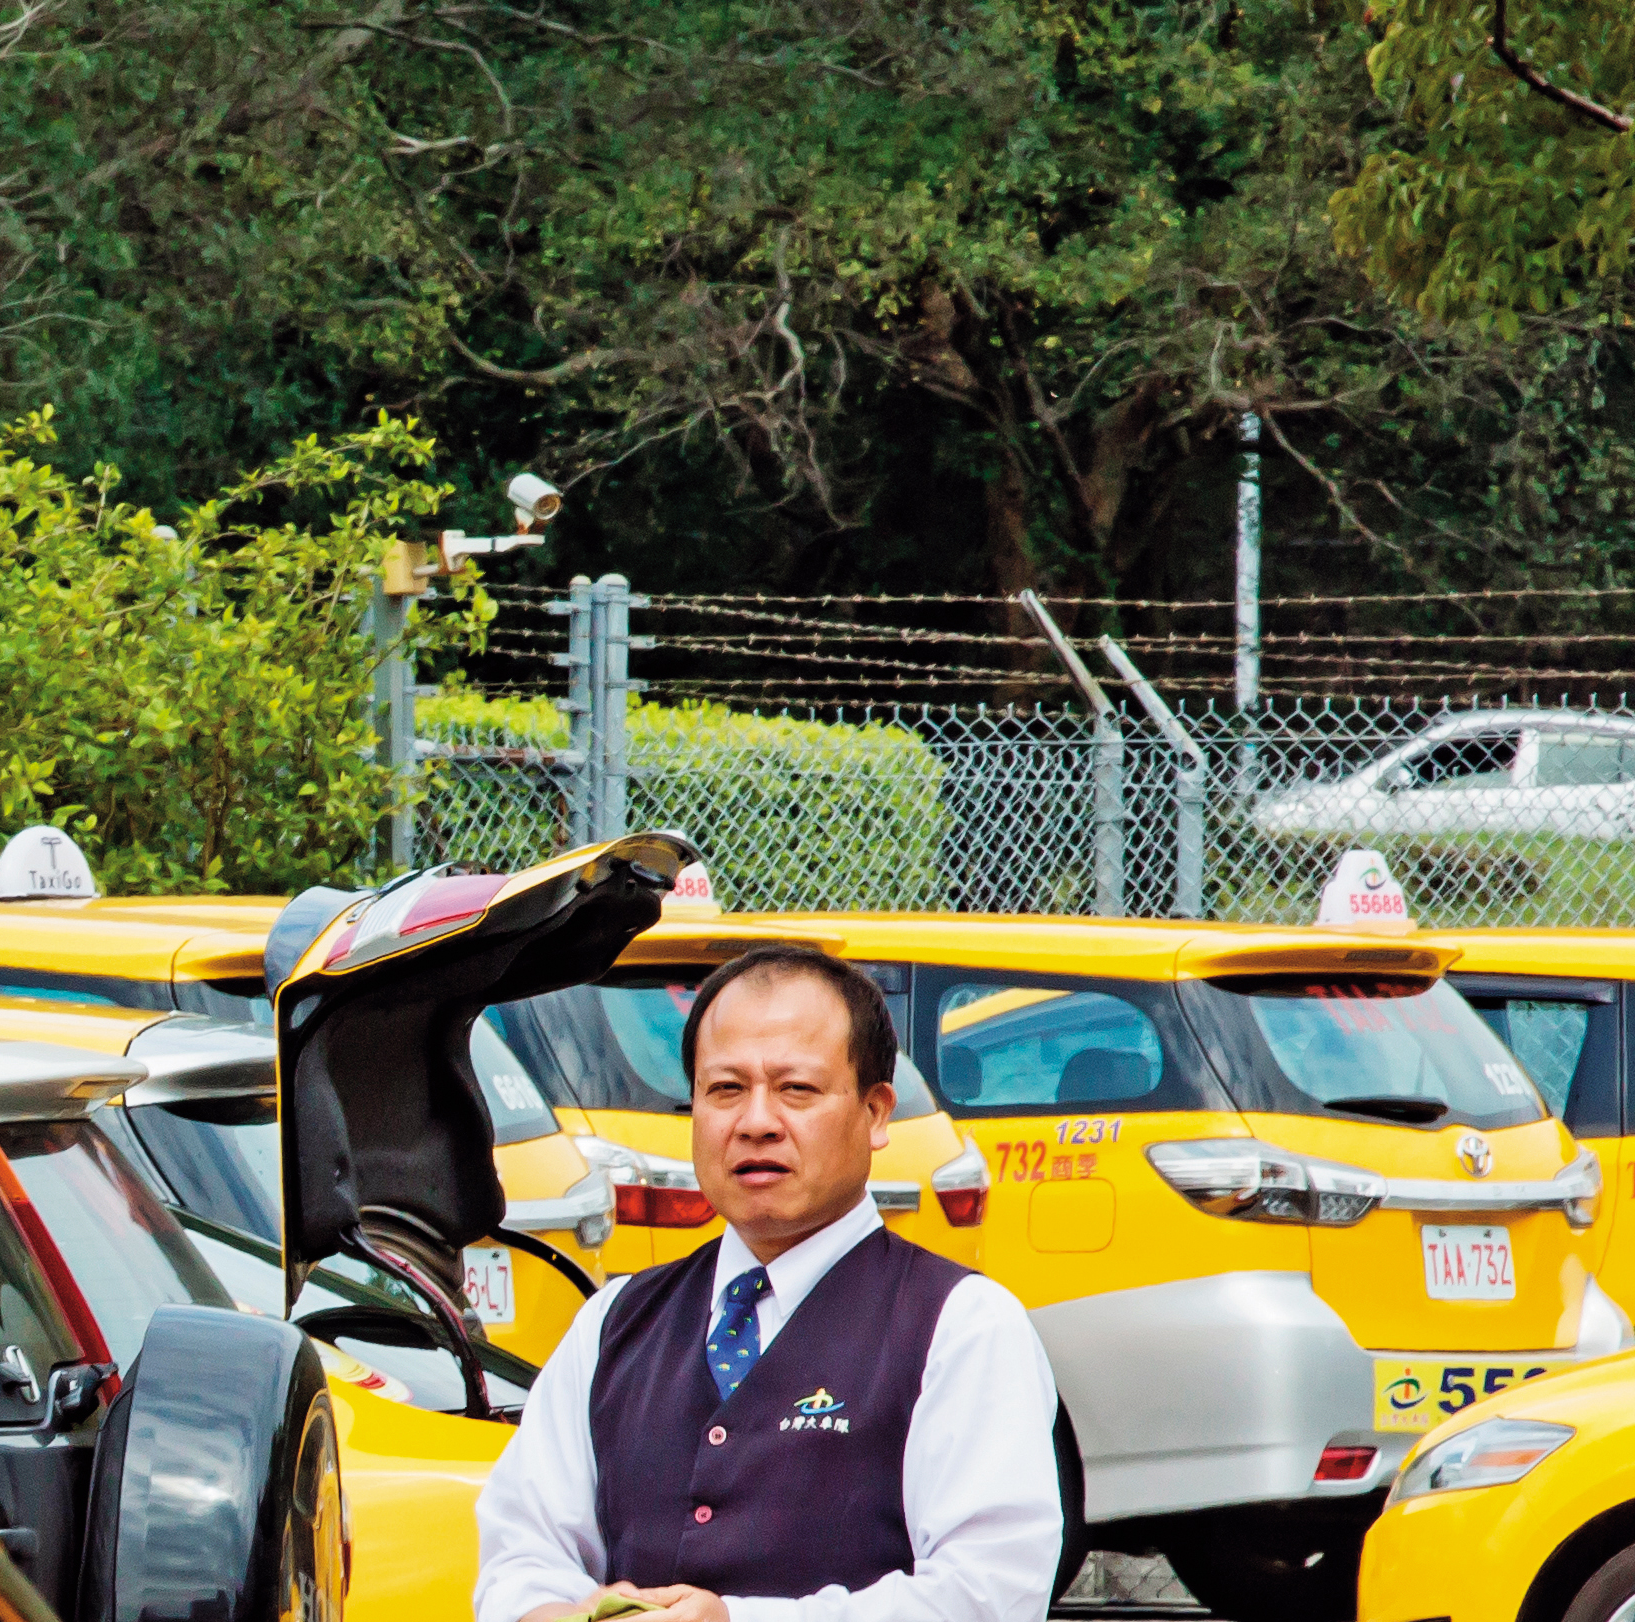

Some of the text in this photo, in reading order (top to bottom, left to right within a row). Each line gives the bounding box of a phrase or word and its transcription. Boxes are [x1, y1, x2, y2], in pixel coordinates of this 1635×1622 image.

[28, 869, 81, 890] TaxiGo
[1349, 893, 1404, 915] 55688
[1055, 1119, 1122, 1145] 1231
[995, 1139, 1048, 1183] 732
[1437, 1366, 1548, 1416] 55
